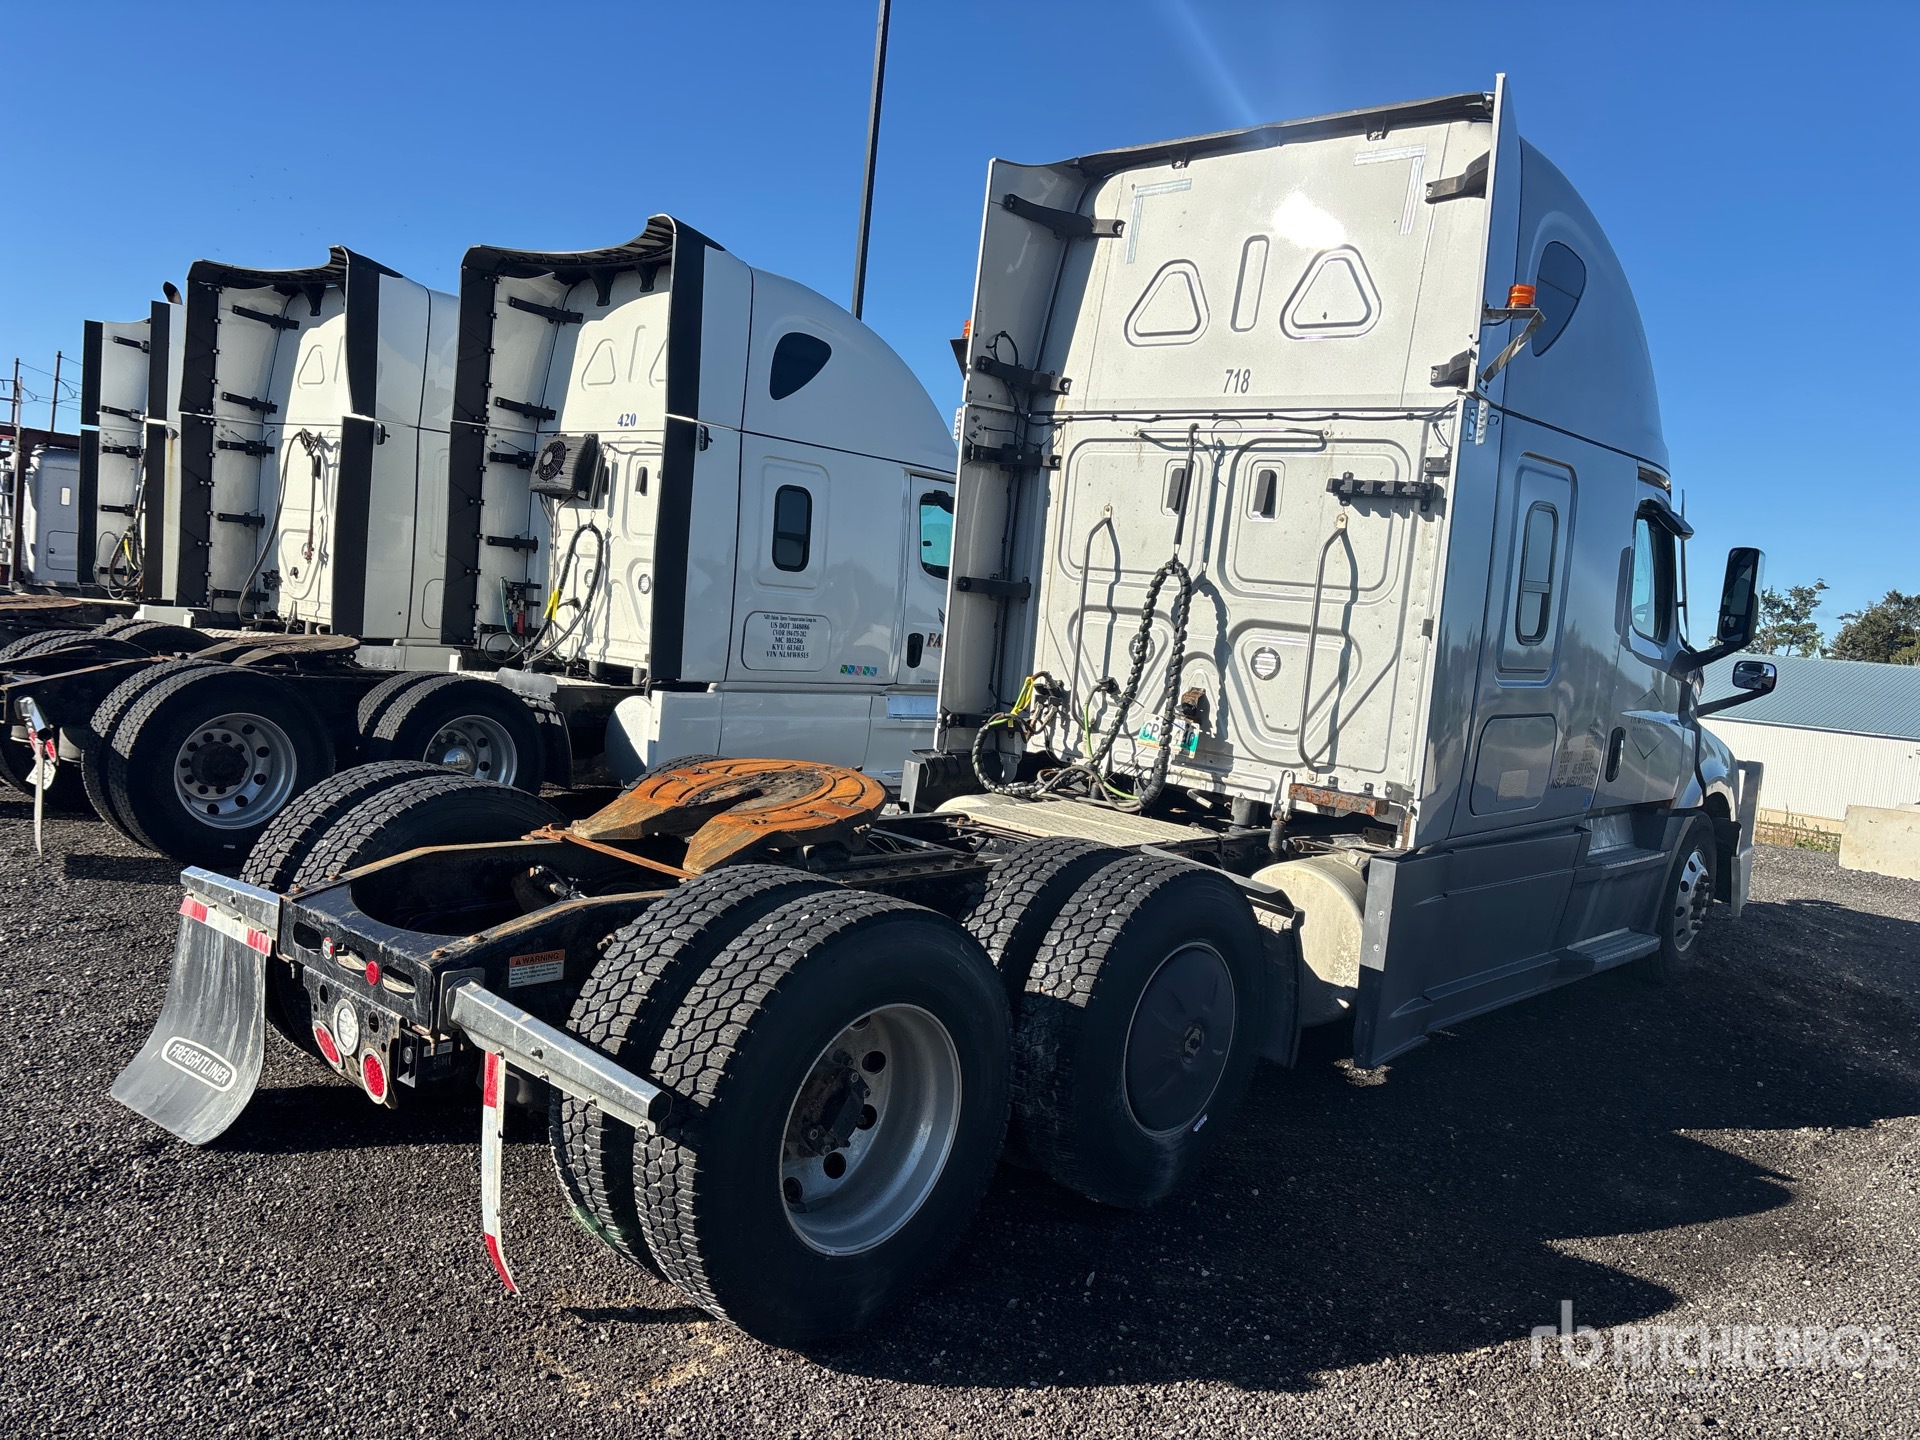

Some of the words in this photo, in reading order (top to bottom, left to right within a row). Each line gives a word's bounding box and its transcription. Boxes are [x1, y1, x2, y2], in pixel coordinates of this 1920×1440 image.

[1223, 368, 1251, 394] 718
[617, 413, 637, 427] 420
[926, 632, 943, 649] FA
[522, 952, 559, 964] WARNING
[168, 1043, 231, 1085] FREIGHTLINER
